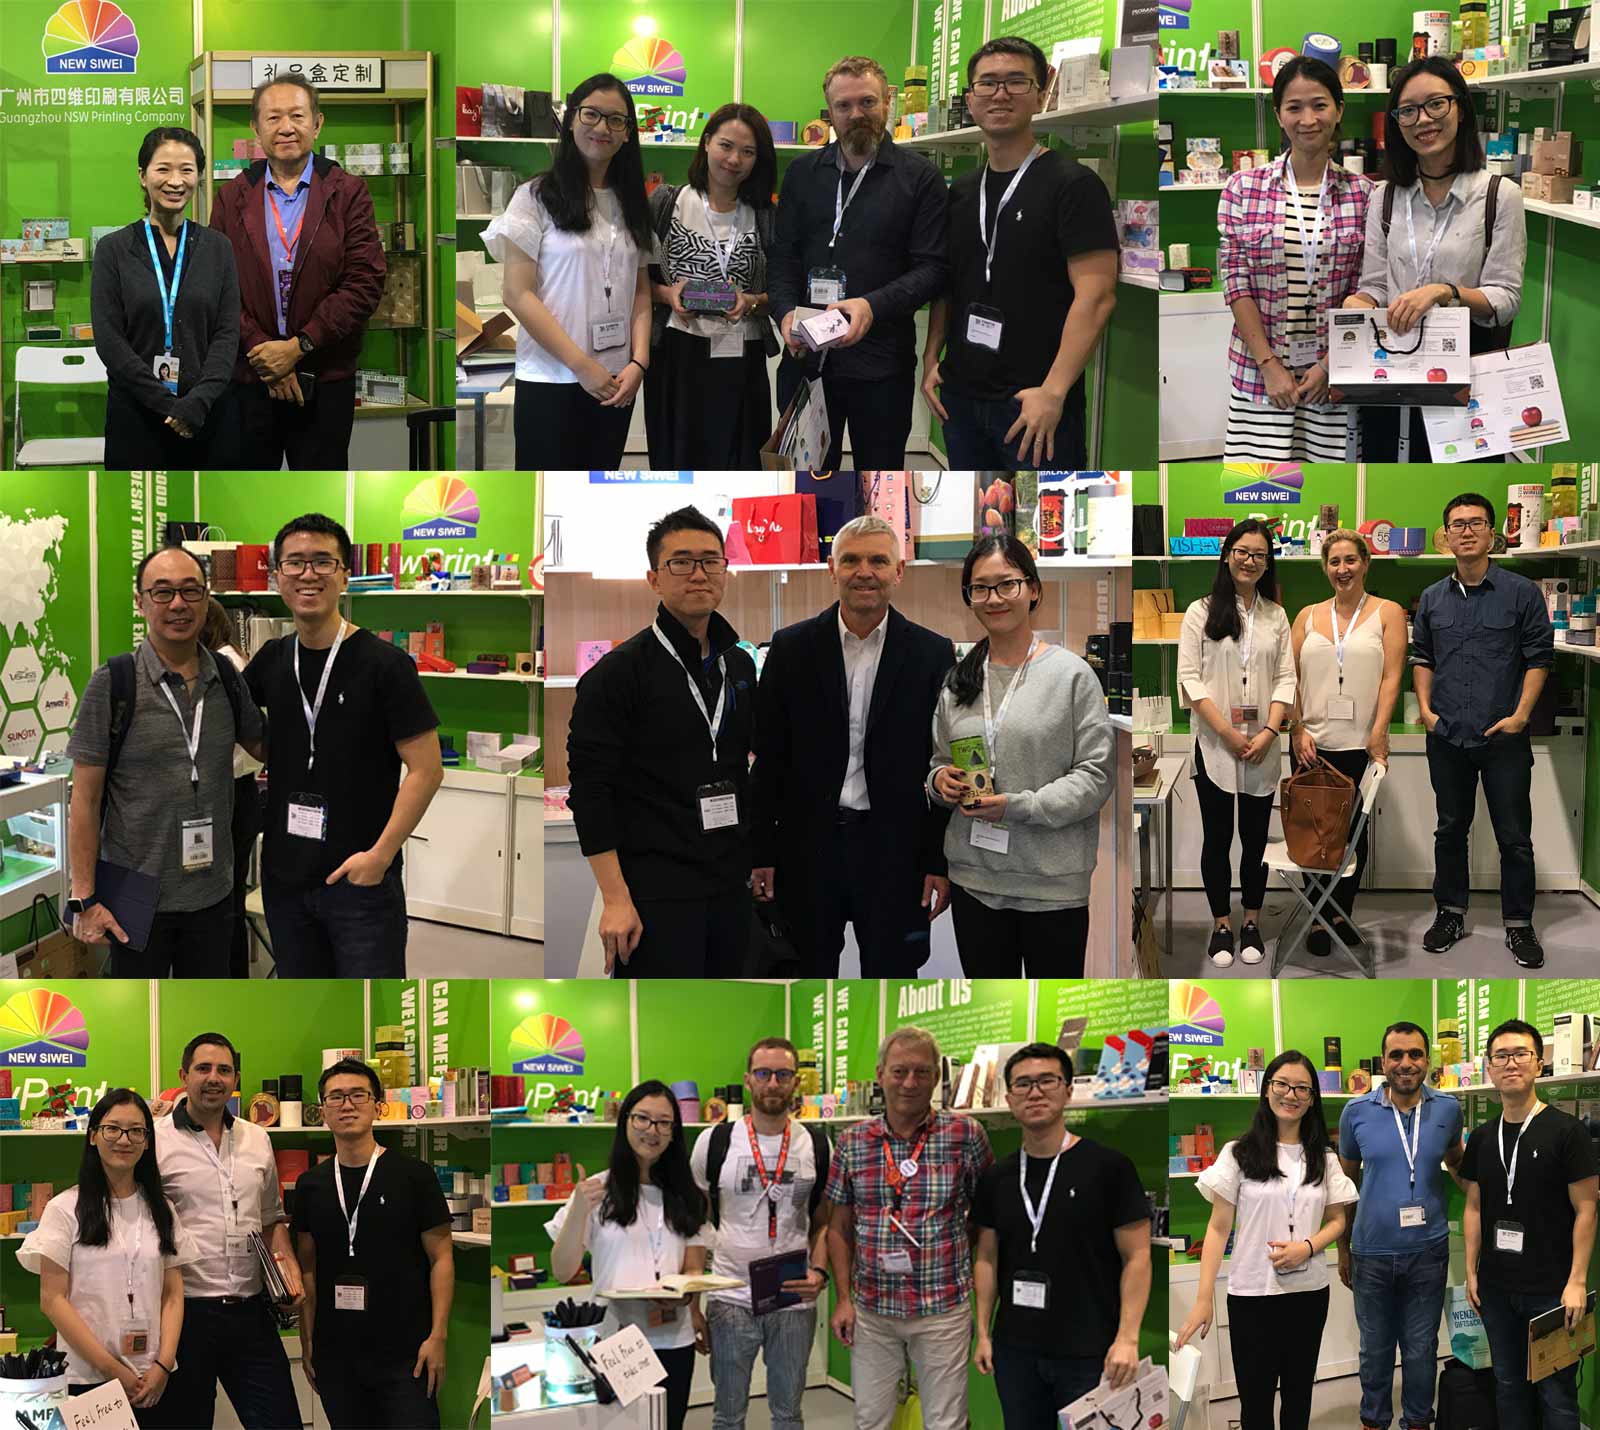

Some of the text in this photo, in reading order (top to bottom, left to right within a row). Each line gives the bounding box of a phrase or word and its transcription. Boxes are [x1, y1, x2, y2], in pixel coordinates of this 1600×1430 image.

[59, 59, 122, 69] NEW SIWEI
[647, 85, 673, 93] SIWEI
[0, 87, 184, 106] 广州市四维印刷有限公司
[0, 111, 185, 125] Guangzhou NSW Printing Company
[1235, 492, 1290, 500] NEW SIWEI
[413, 527, 465, 536] NEW SIWEI
[898, 979, 943, 1018] About
[1478, 984, 1489, 1020] CAN
[433, 981, 448, 1027] CAN
[836, 1017, 848, 1050] CAN
[1184, 1034, 1213, 1043] SIWEI
[8, 1053, 73, 1063] NEW SIWEI
[523, 1063, 545, 1072] NEW
